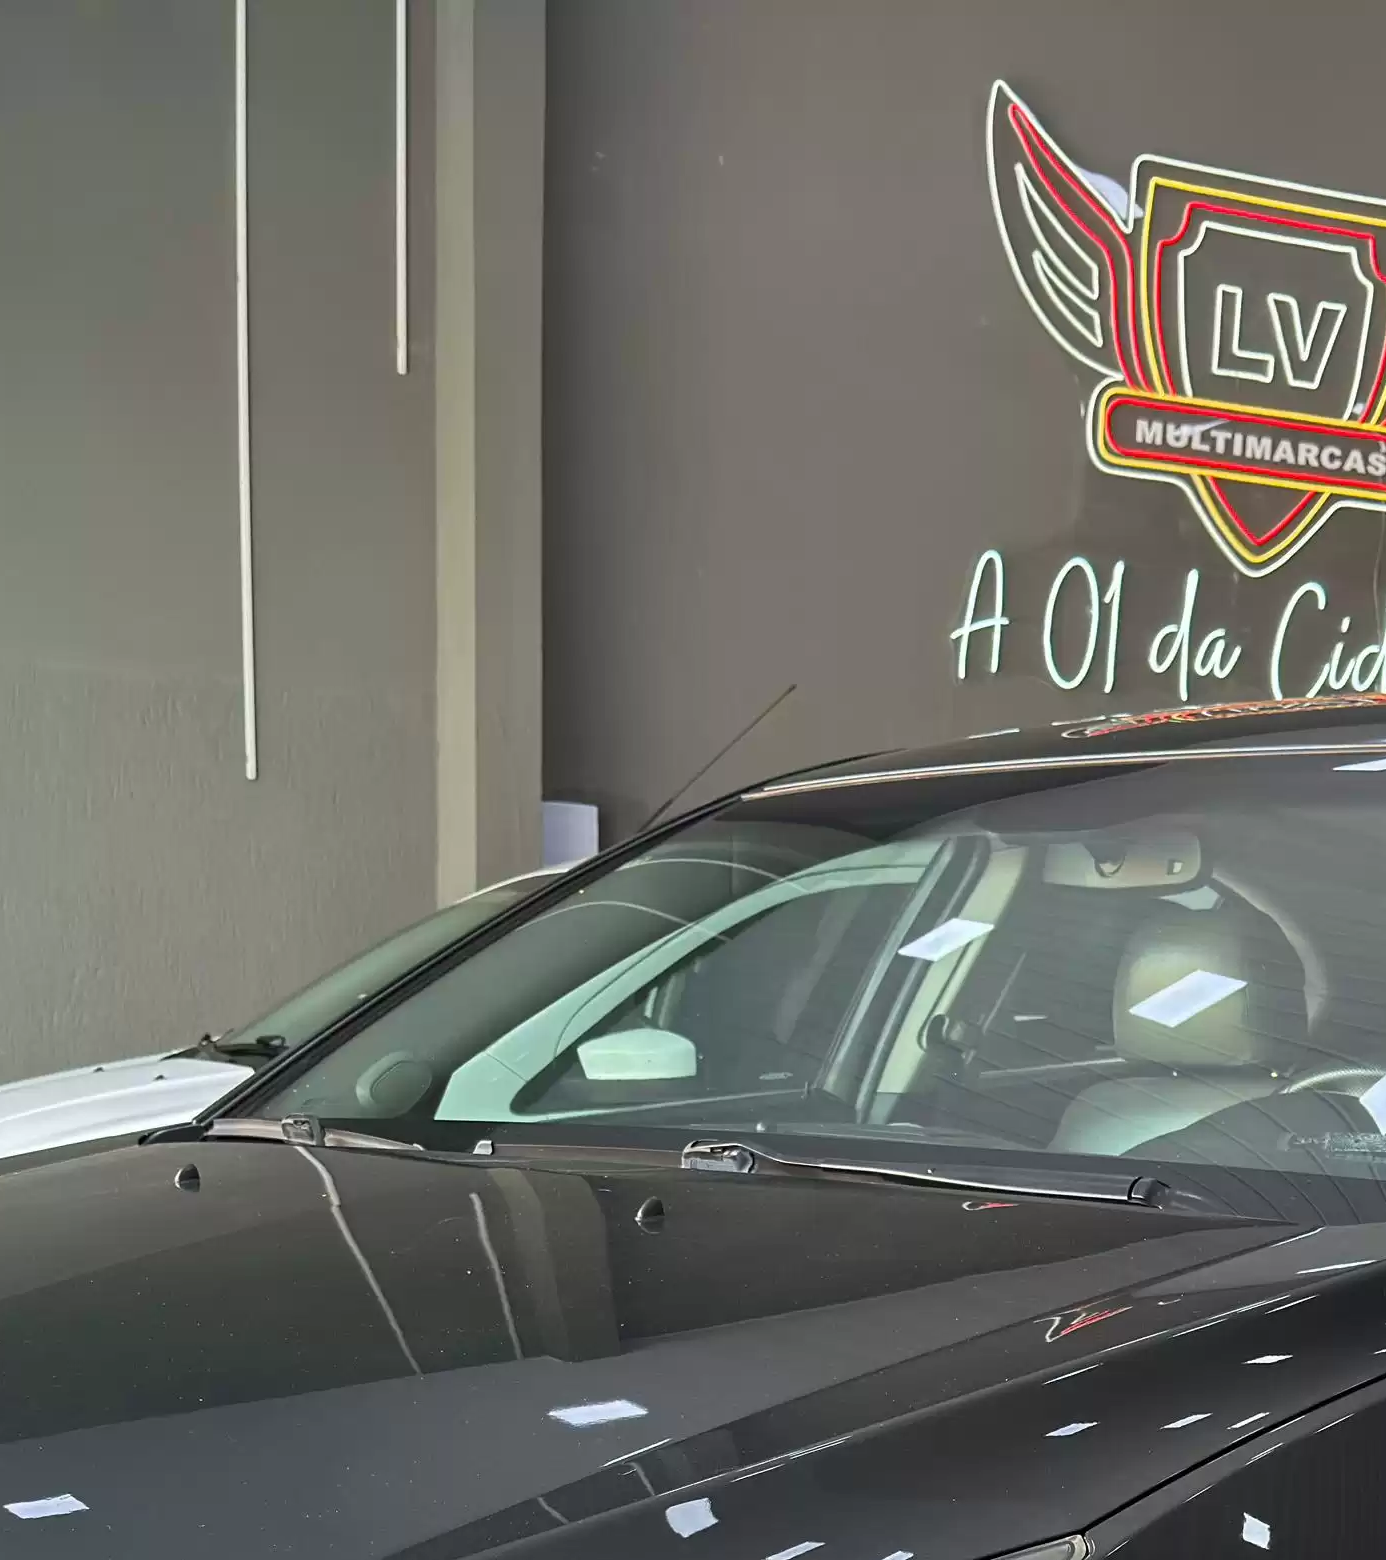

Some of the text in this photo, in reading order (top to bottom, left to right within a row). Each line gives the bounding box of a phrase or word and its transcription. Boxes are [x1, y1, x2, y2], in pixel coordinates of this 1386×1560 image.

[1212, 284, 1346, 389] LV
[950, 549, 1009, 680] A
[1148, 568, 1241, 701] da
